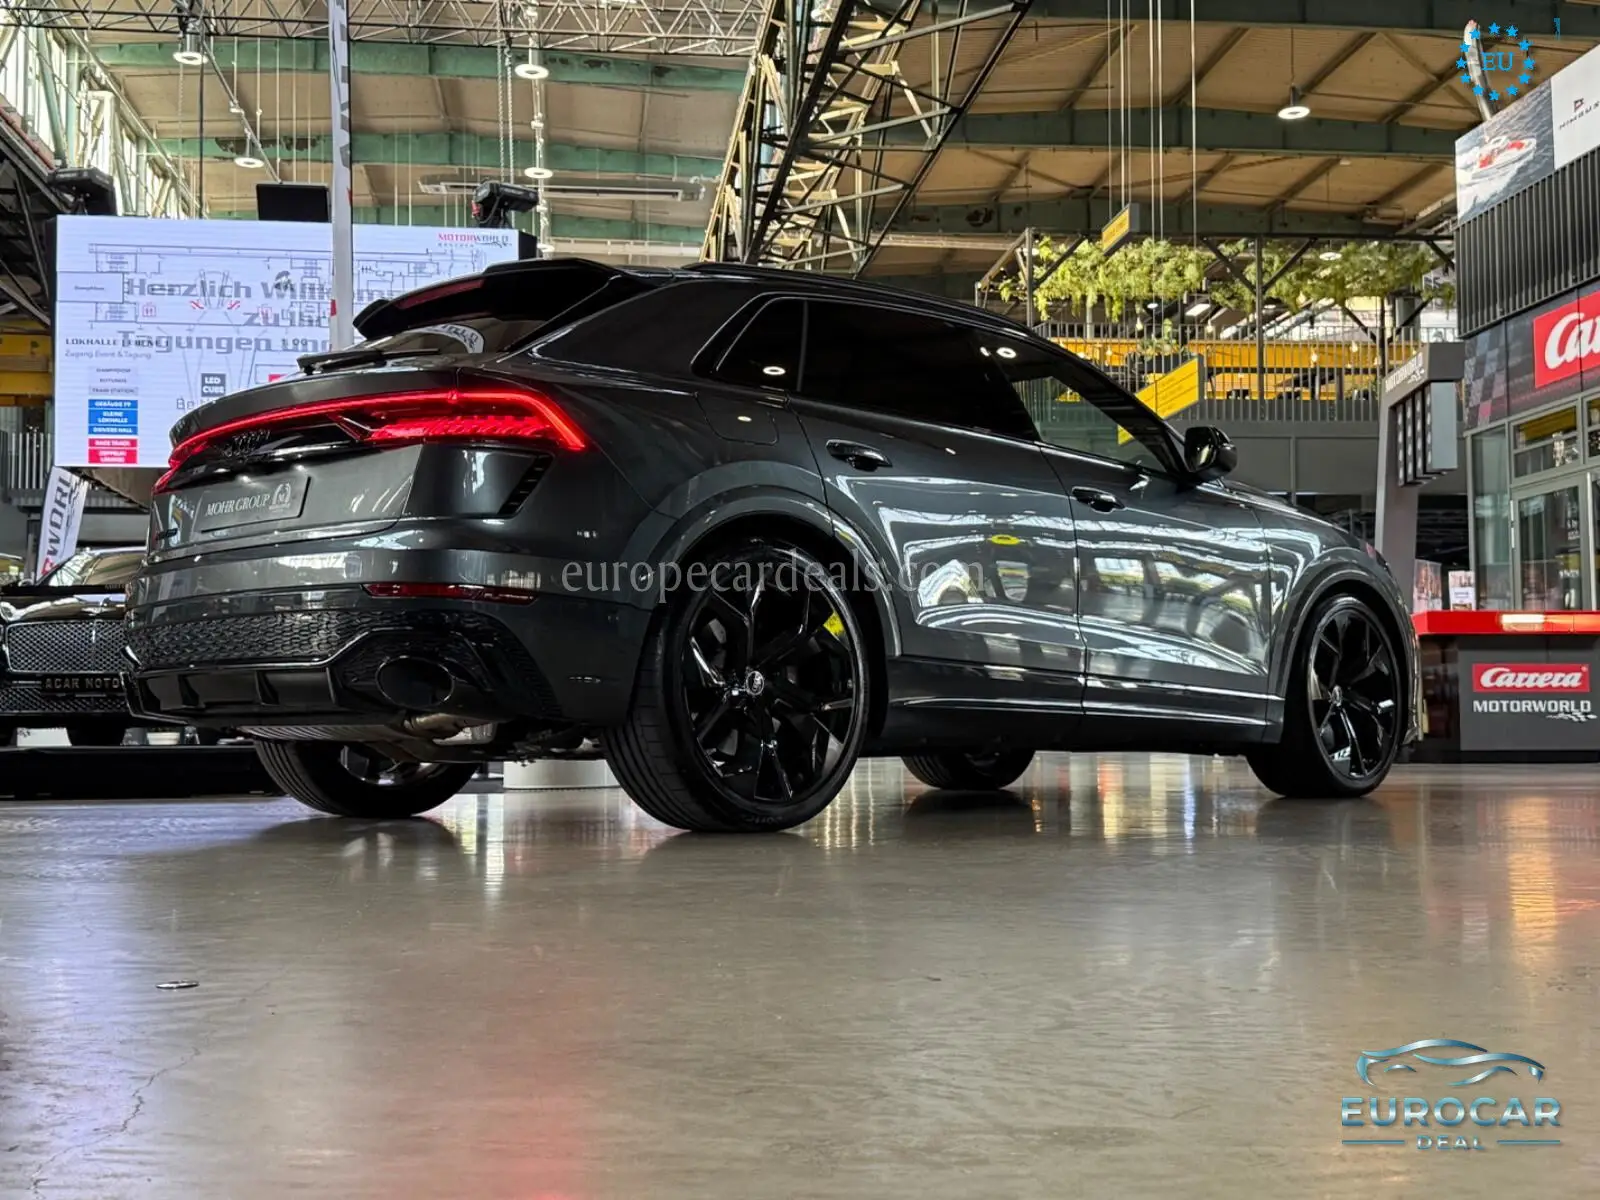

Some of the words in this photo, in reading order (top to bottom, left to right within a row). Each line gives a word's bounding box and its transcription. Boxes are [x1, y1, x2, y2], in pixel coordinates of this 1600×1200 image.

[128, 278, 251, 298] Herzlich
[117, 331, 272, 354] Tagungen
[203, 386, 225, 394] CUBE
[204, 376, 221, 384] LED
[205, 499, 235, 517] MOHR
[235, 493, 271, 512] GROUP
[1480, 667, 1583, 689] Carrera
[1472, 699, 1592, 713] MOTORWORLD
